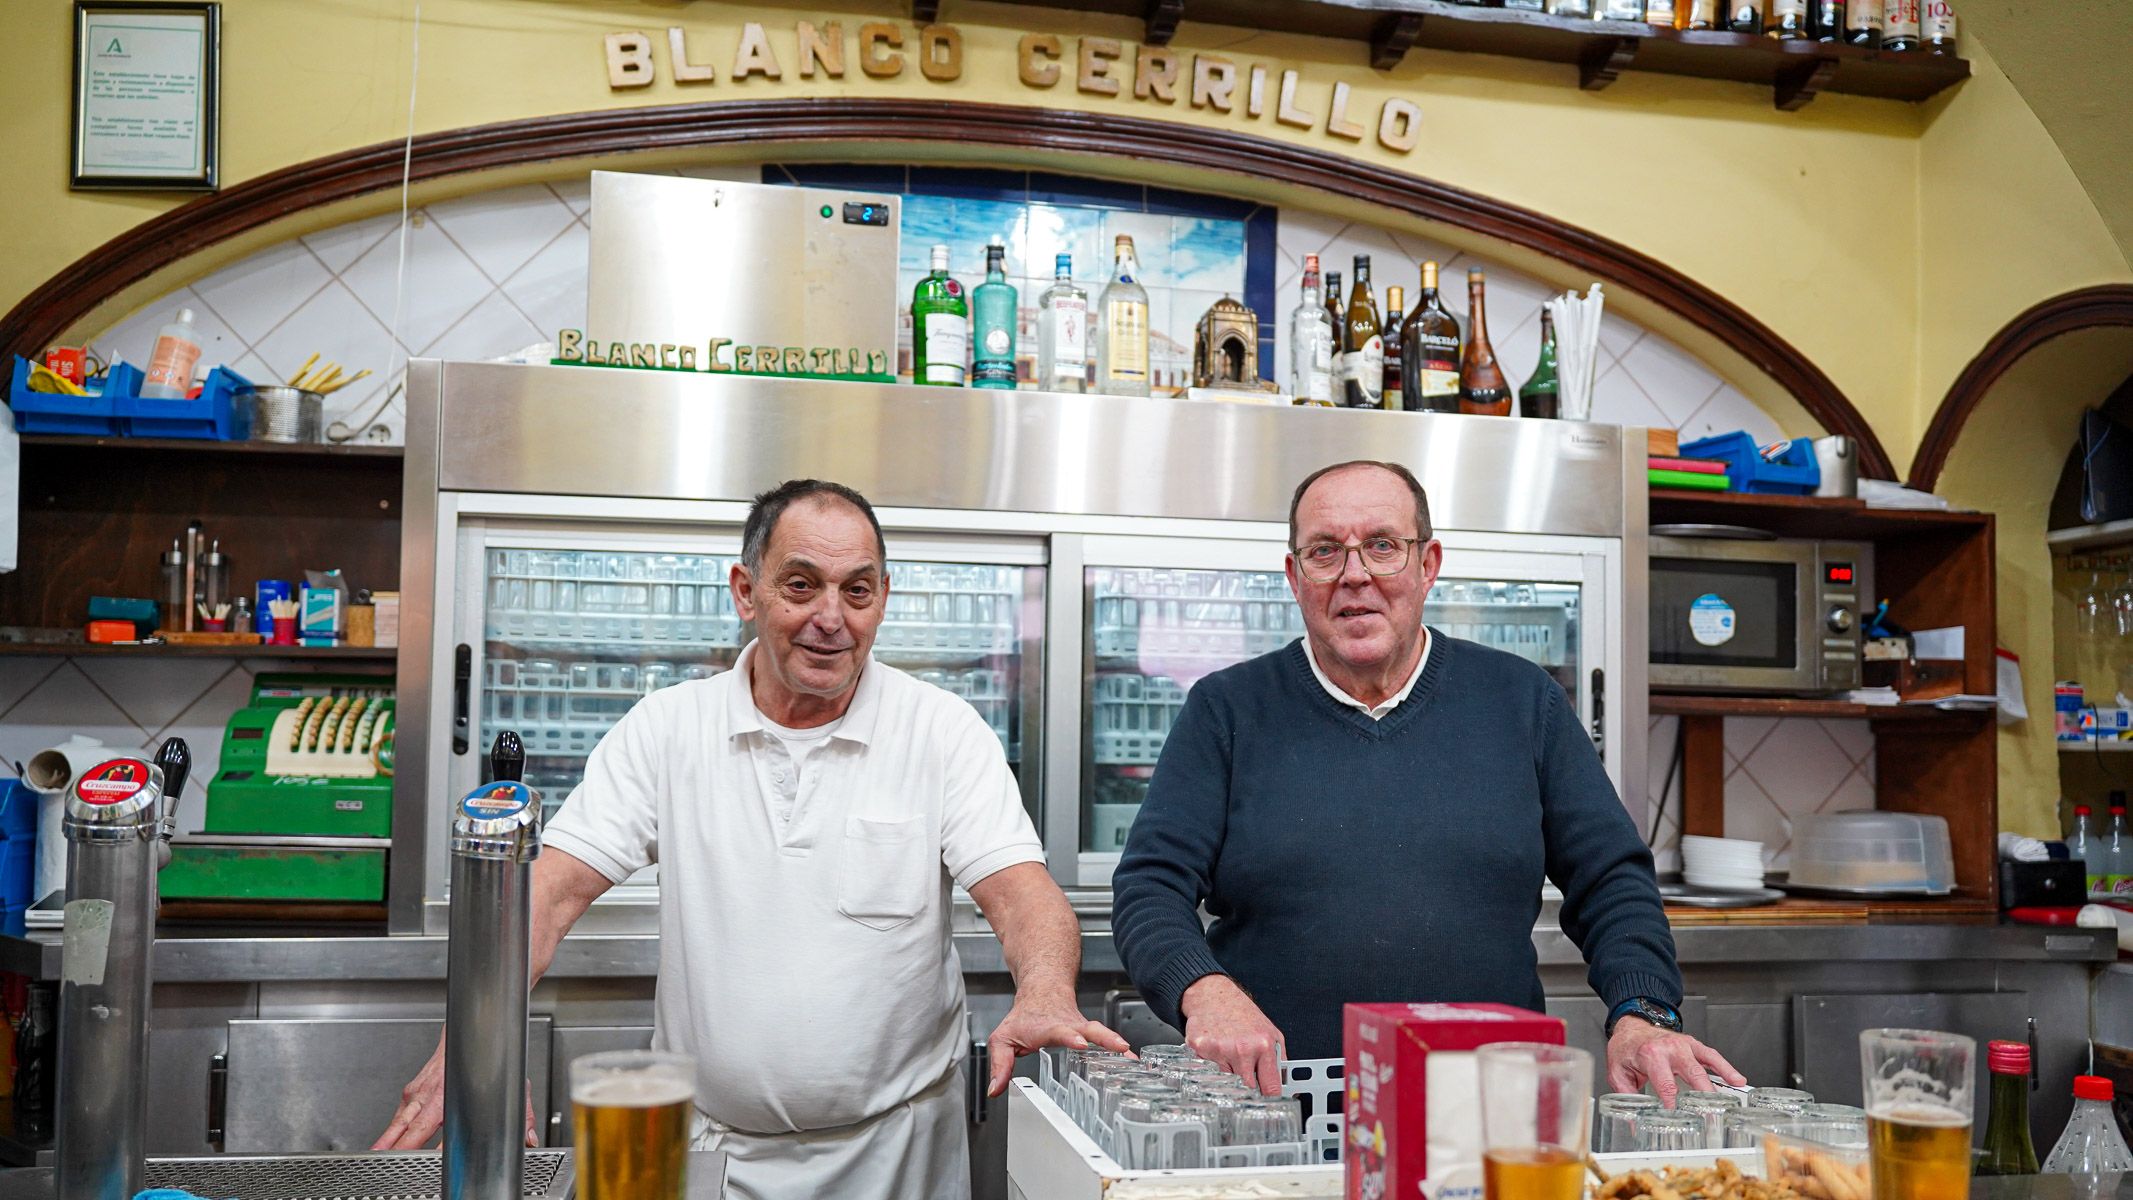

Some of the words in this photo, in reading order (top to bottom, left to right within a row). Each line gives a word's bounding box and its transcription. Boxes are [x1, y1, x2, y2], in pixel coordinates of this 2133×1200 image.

[604, 20, 963, 89] BLANCO
[1017, 32, 1423, 152] CERRILLO
[862, 207, 873, 221] 2
[558, 328, 697, 370] BLANCO
[708, 337, 888, 375] CERRILLO
